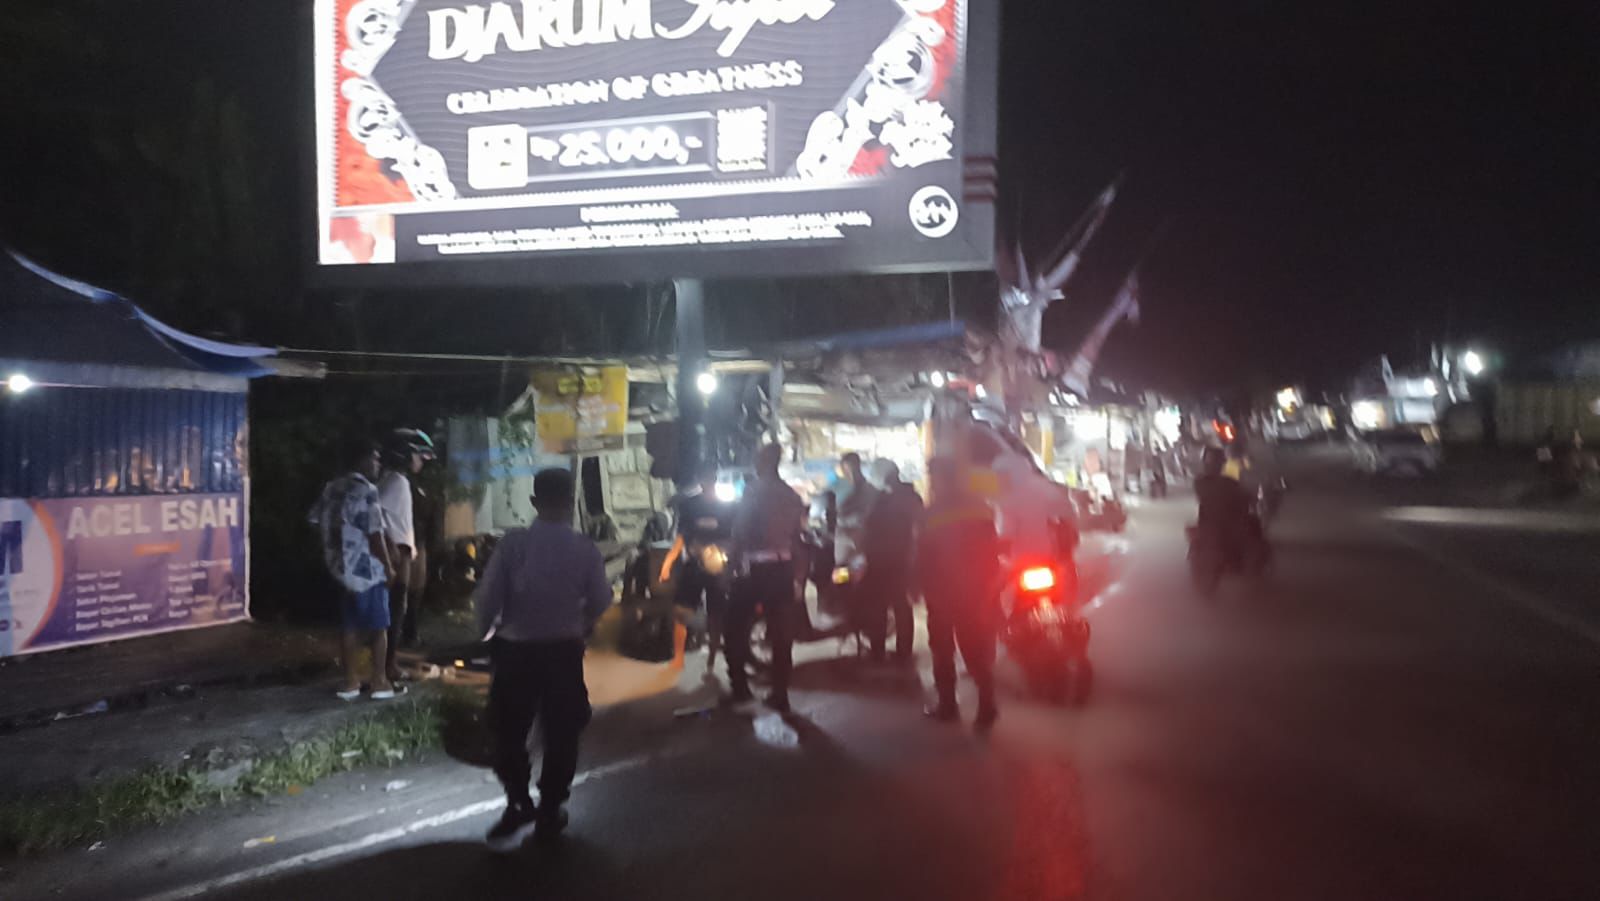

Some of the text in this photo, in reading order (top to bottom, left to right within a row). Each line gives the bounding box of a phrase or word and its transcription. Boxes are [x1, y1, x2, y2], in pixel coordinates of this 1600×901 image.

[428, 0, 654, 61] DJARUM
[612, 75, 648, 100] OF
[66, 496, 239, 540] ACEL ESAH
